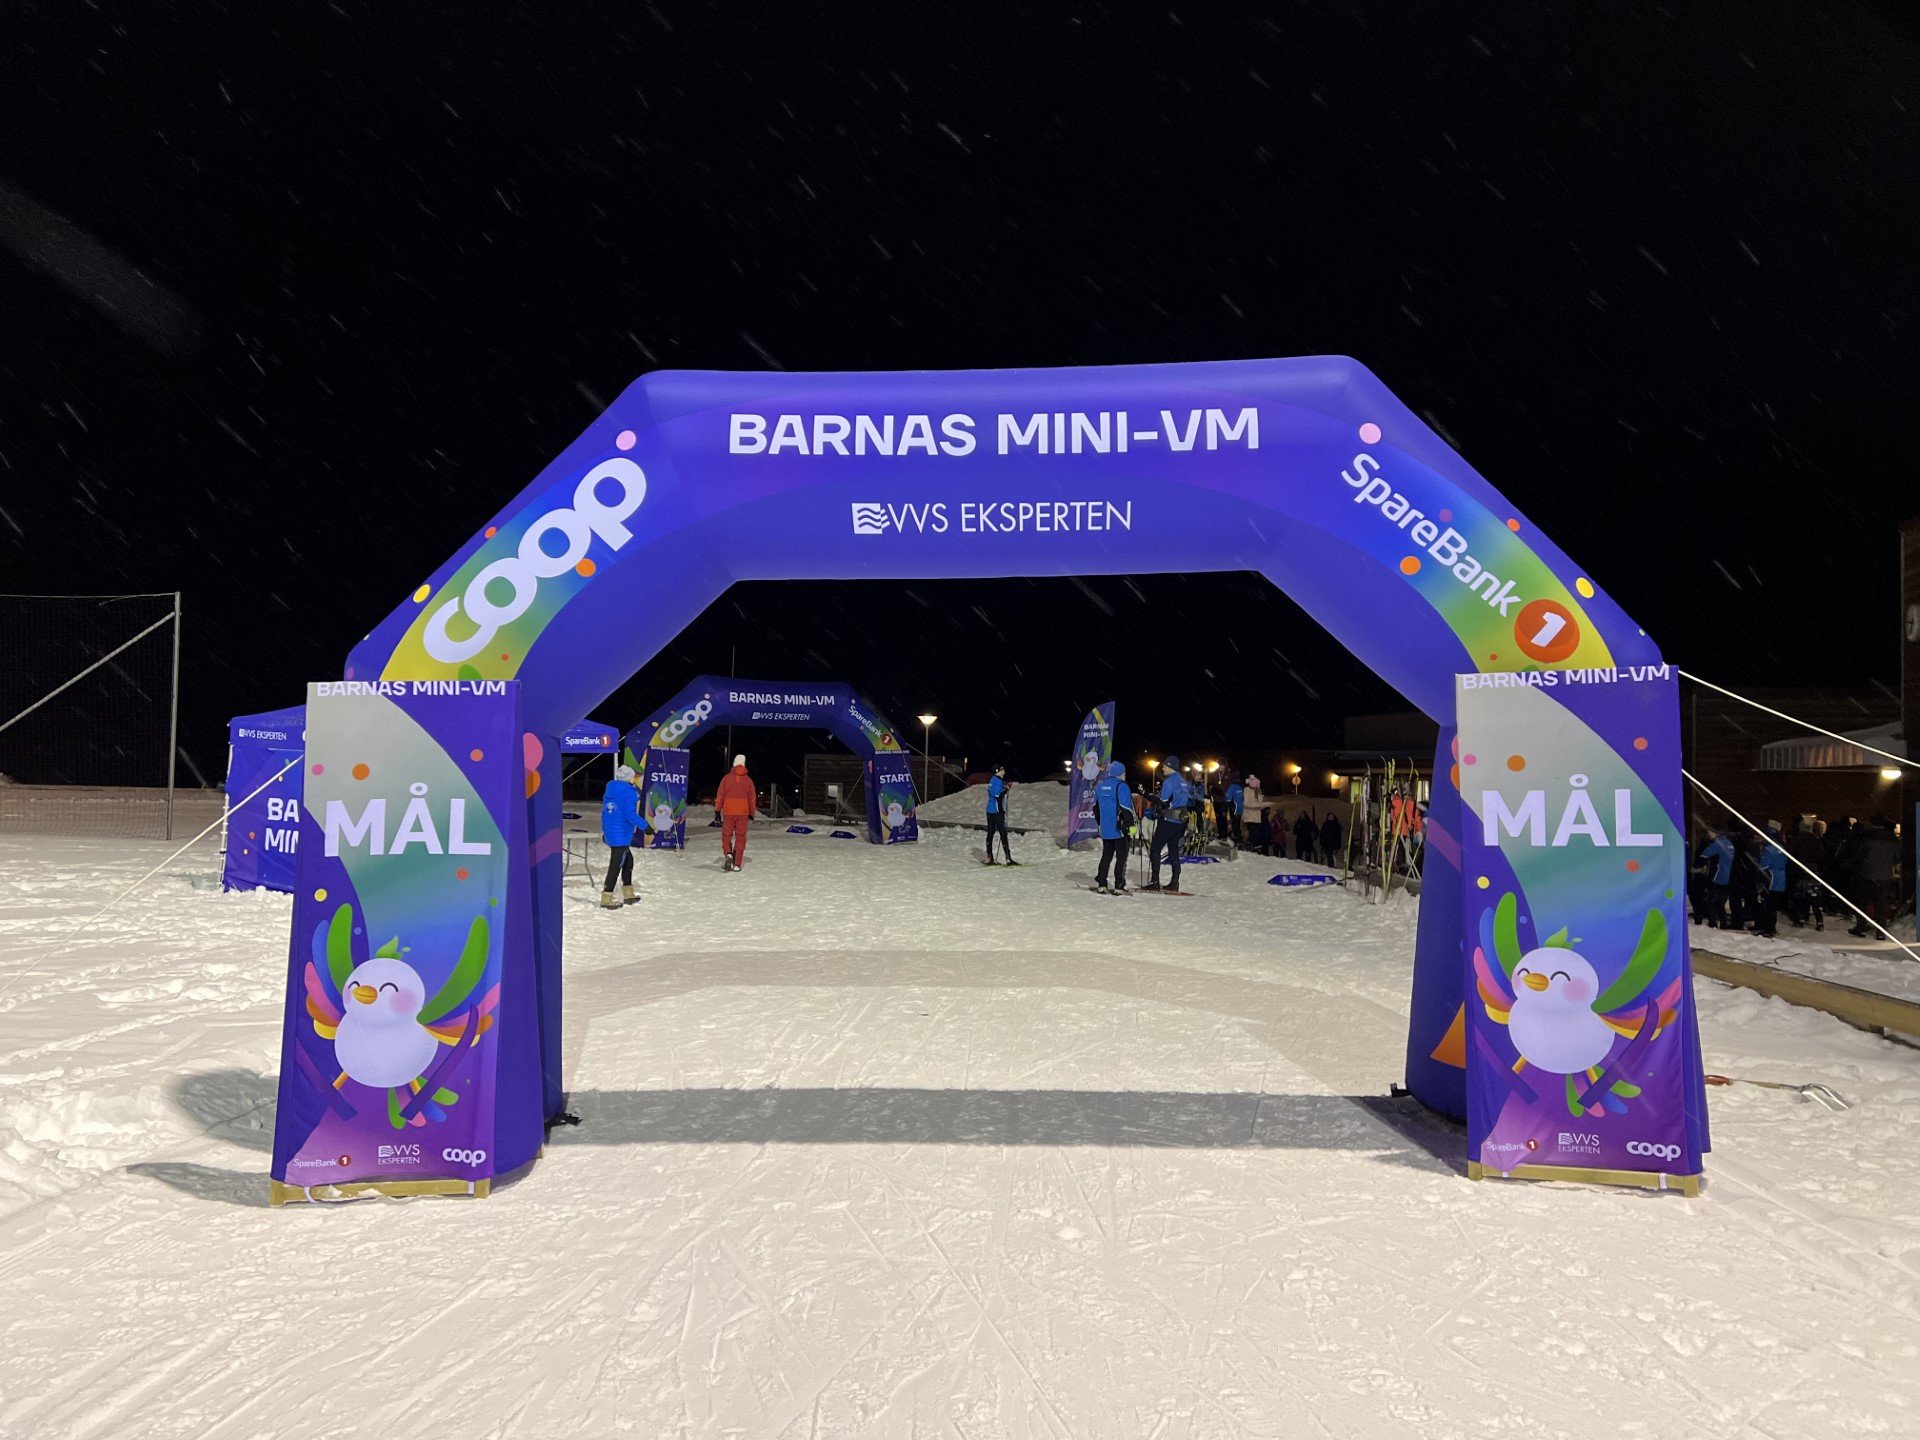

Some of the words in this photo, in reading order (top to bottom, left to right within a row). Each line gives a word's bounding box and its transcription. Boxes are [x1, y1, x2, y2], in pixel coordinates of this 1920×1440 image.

[728, 412, 977, 457] BARNAS
[997, 407, 1260, 455] MINI-VM
[961, 501, 1132, 533] EKSPERTEN
[1341, 453, 1521, 617] SpareBank
[1530, 611, 1566, 647] 1
[423, 457, 647, 663] coop
[1462, 670, 1558, 689] BARNAS
[1565, 666, 1670, 685] MINI-VM
[316, 681, 406, 697] BARNAS
[412, 681, 506, 696] MINI-VM
[729, 692, 781, 705] BARNAS
[784, 694, 835, 706] MINI-VM
[660, 698, 712, 742] coop
[774, 713, 811, 721] EKSPERTEN
[848, 705, 882, 738] SpareBank
[256, 730, 287, 741] EKSPERTEN
[565, 736, 600, 746] SpareBank
[651, 771, 687, 784] START
[879, 773, 911, 784] START
[1482, 773, 1664, 848] MÅL
[324, 782, 492, 858] MÅL
[1486, 1140, 1526, 1152] SpareBank
[1558, 1145, 1600, 1154] EKSPERTEN
[1626, 1141, 1681, 1161] coop
[294, 1157, 337, 1168] SpareBank
[378, 1156, 420, 1165] EKSPERTEN
[442, 1148, 486, 1167] coop
